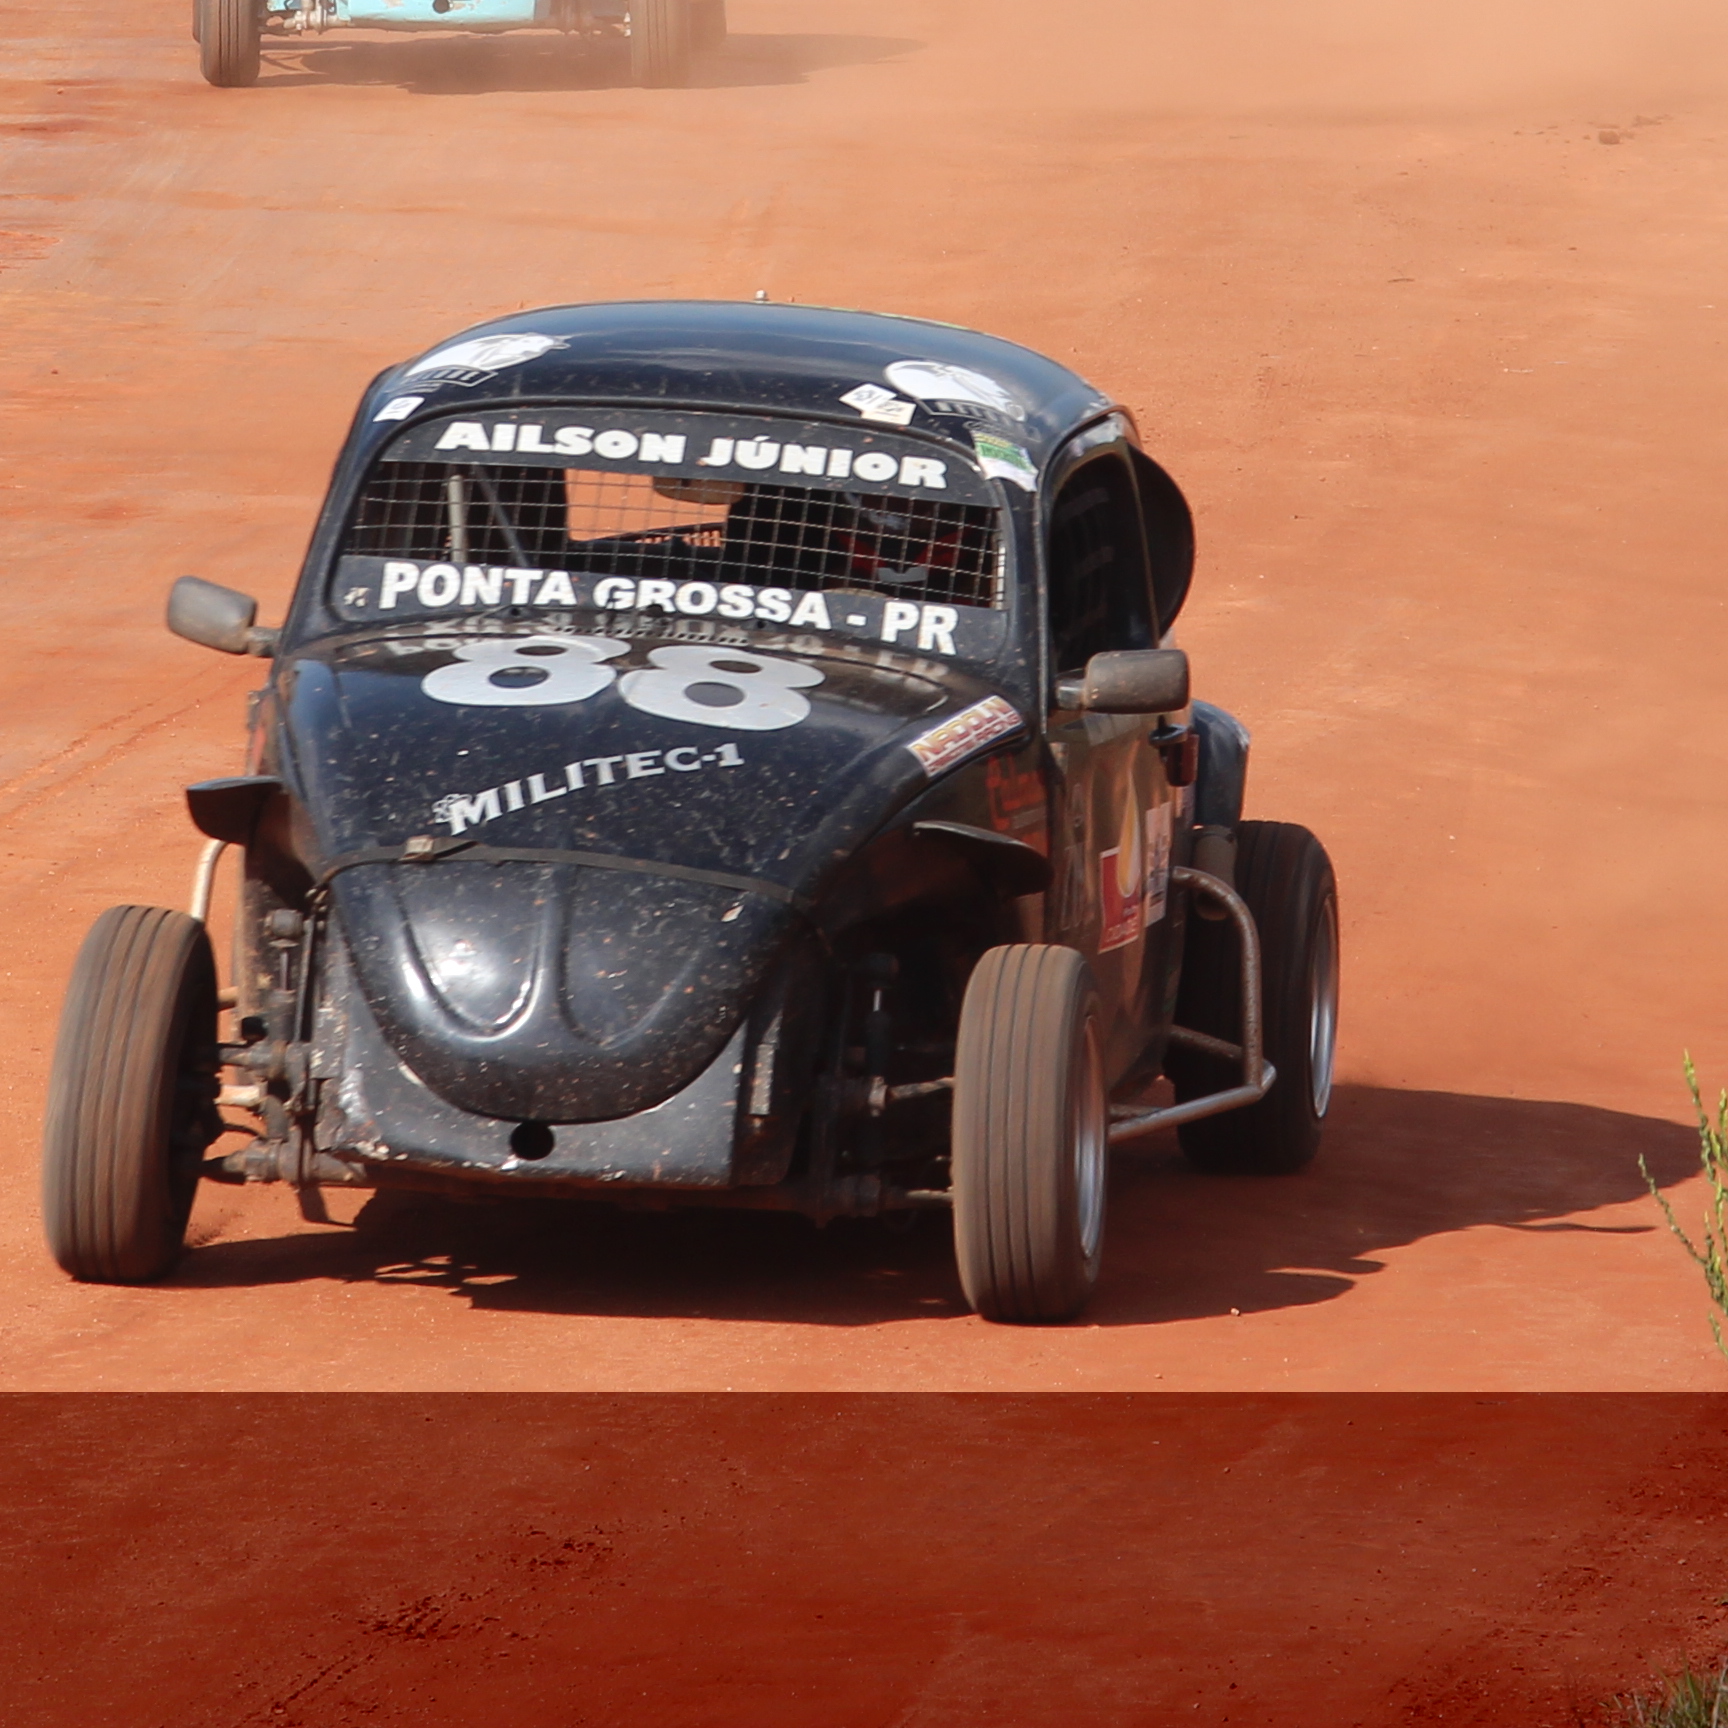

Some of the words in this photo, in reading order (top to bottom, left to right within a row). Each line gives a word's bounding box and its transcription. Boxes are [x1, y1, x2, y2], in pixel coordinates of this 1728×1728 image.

[434, 420, 687, 466] AILSON
[700, 434, 949, 490] JÚNIOR
[378, 560, 579, 612] PONTA
[593, 575, 832, 632] GROSSA
[880, 600, 959, 657] PR
[420, 634, 827, 732] 88
[445, 741, 746, 836] MILITEC-1
